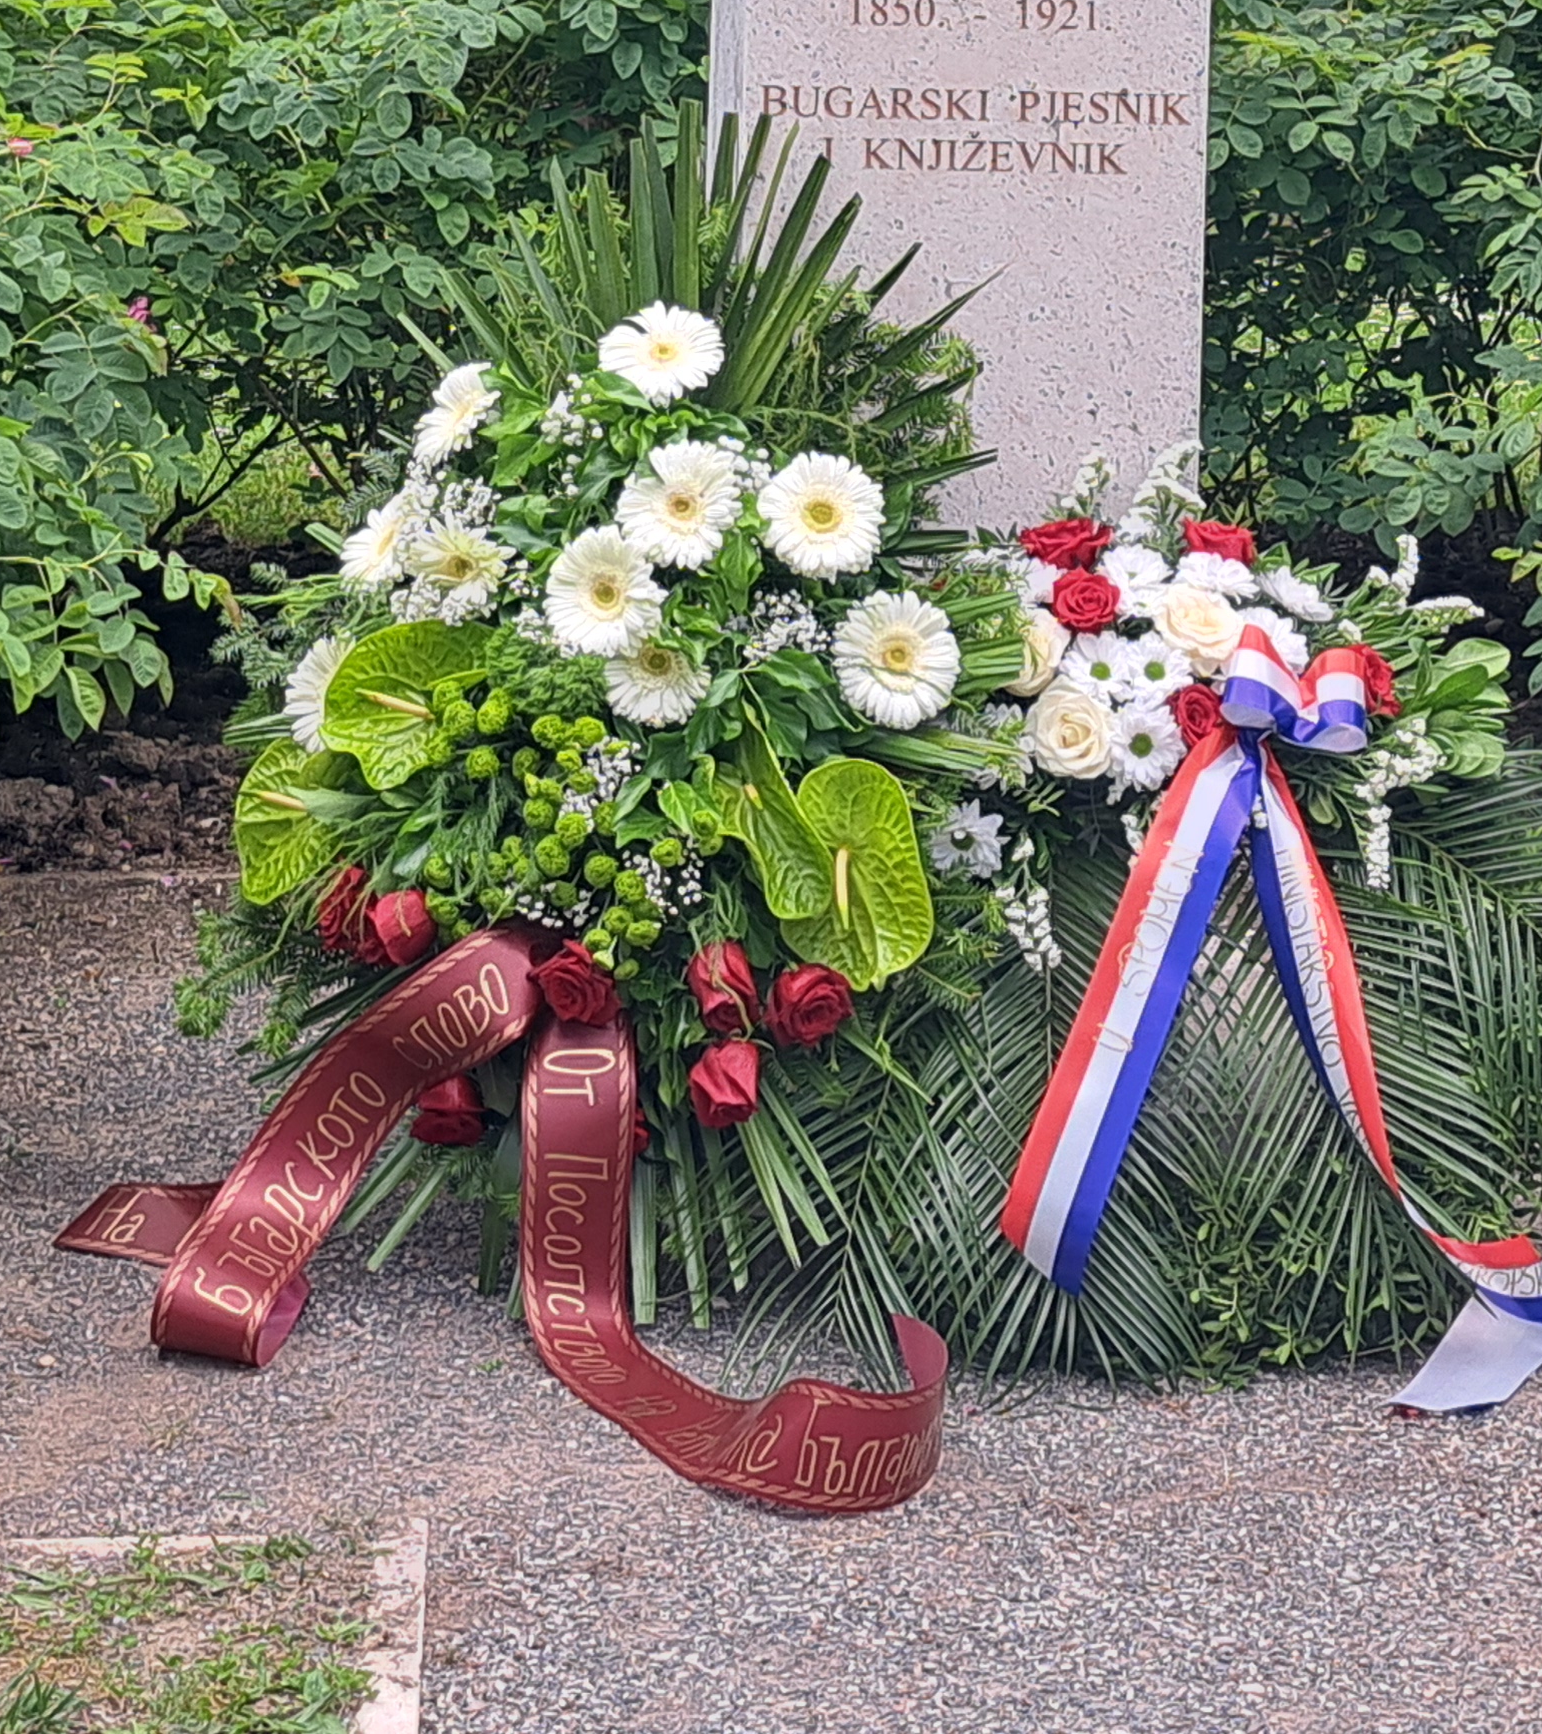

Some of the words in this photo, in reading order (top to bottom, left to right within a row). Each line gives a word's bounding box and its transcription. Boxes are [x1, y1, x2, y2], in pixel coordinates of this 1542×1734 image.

[761, 85, 990, 121] BUGARSKI
[1017, 89, 1191, 126] PJESNIK
[822, 137, 835, 167] I
[864, 131, 1129, 175] KNJIŽEVNIK
[1117, 839, 1204, 998] SPOMEN
[543, 1048, 616, 1106] От
[85, 1188, 146, 1244] На
